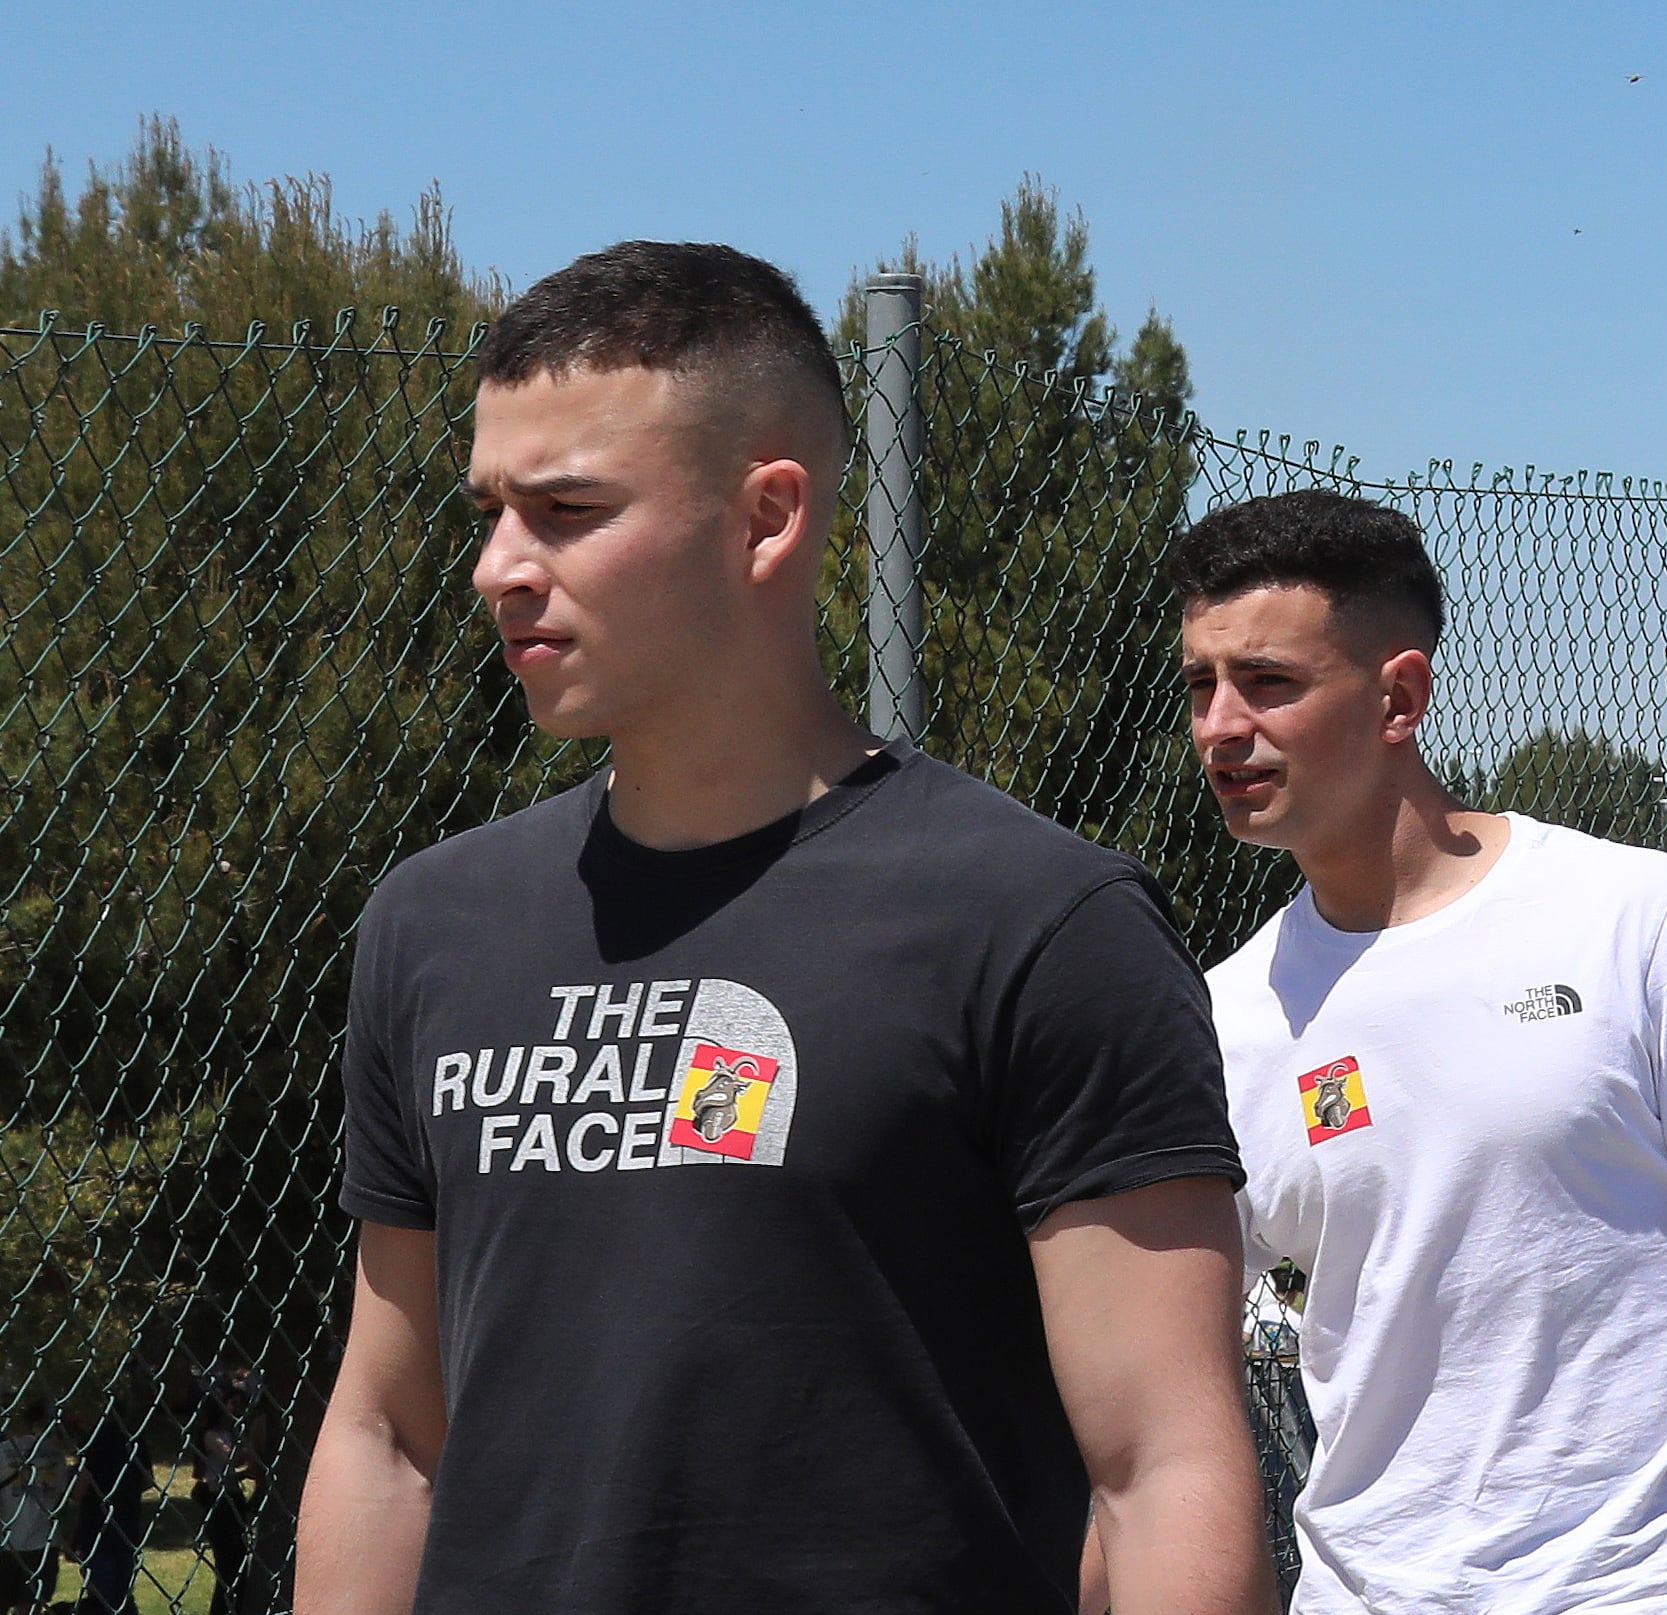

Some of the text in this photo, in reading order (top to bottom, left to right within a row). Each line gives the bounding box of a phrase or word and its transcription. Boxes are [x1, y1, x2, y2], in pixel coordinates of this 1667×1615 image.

[550, 979, 692, 1041] THE
[1503, 996, 1555, 1016] NORTH
[1525, 985, 1553, 1000] THE
[1519, 1007, 1556, 1023] FACE
[431, 1043, 668, 1117] RURAL
[478, 1111, 662, 1174] FACE
